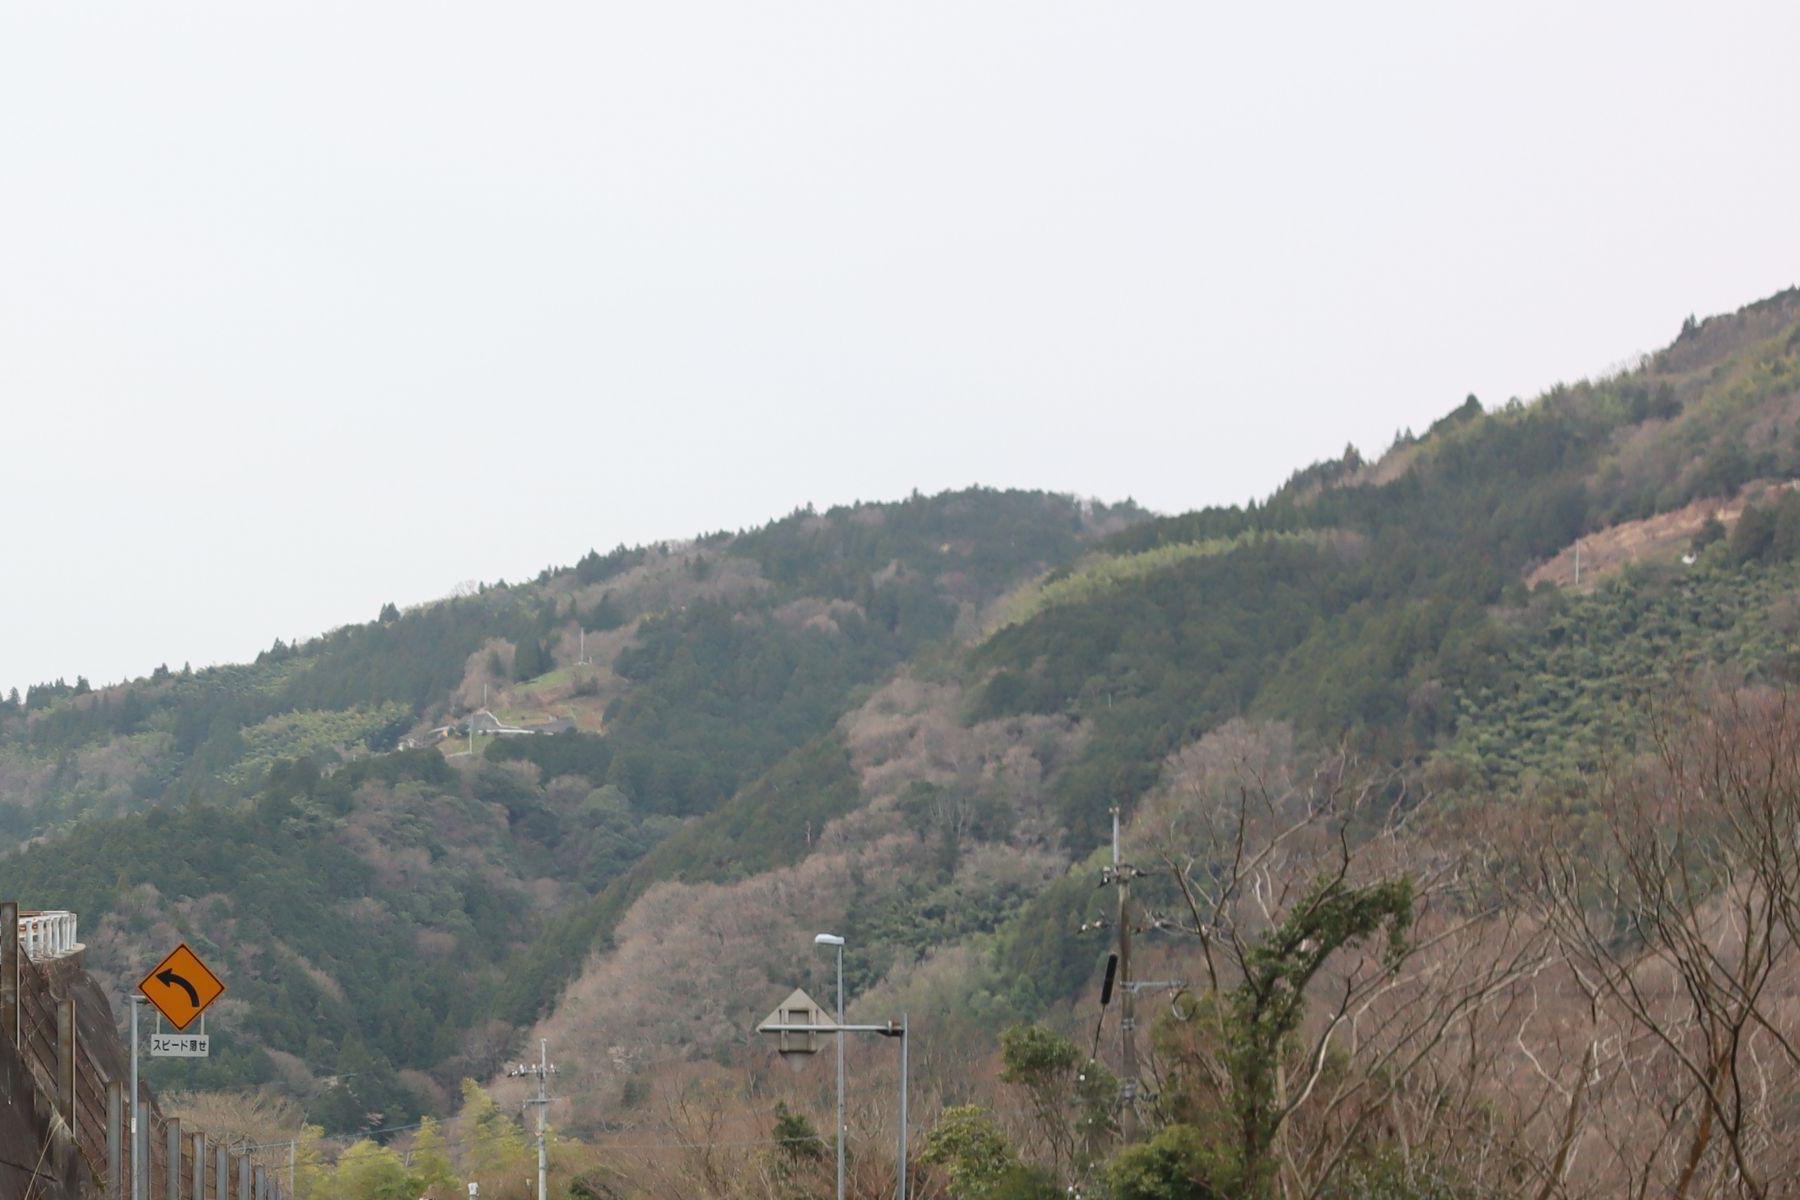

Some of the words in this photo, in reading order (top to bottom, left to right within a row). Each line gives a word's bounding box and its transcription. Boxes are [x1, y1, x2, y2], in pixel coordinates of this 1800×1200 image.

[153, 1039, 207, 1052] スピード落せ
